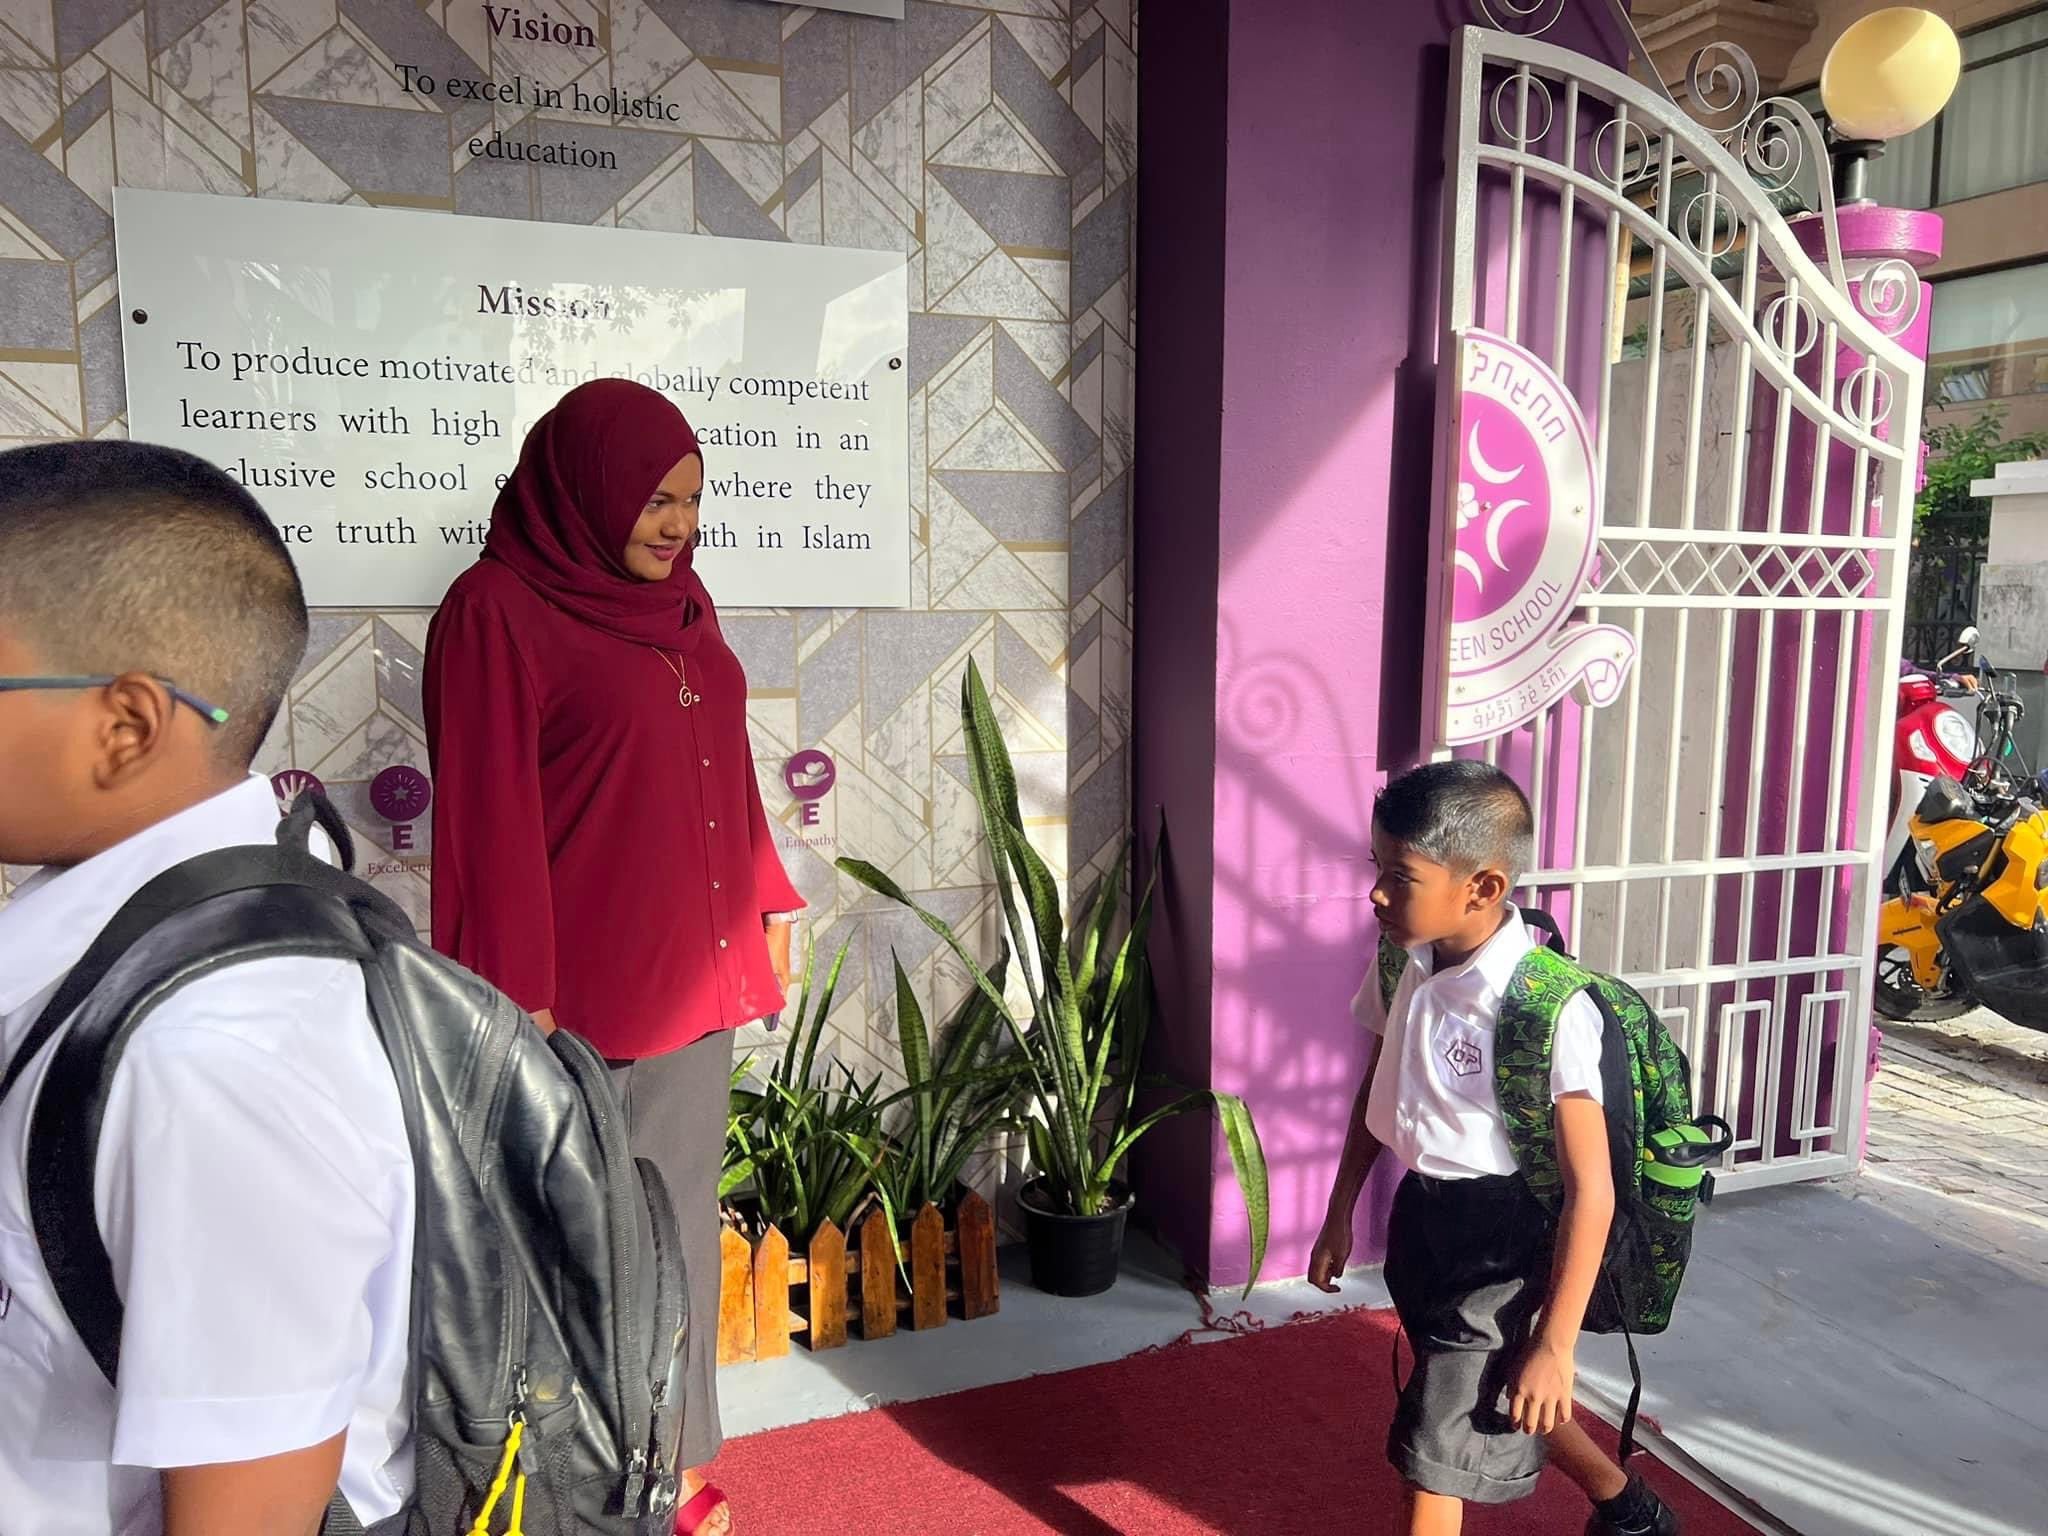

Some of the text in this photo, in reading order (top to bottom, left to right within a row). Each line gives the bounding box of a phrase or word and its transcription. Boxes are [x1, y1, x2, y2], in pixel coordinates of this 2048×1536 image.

[482, 4, 597, 49] Vision
[394, 62, 681, 122] To excel in holistic
[468, 130, 618, 170] education
[176, 341, 221, 371] To
[231, 345, 370, 381] produce
[379, 355, 537, 385] motivated
[546, 361, 598, 386] and
[729, 375, 870, 405] competent
[180, 398, 317, 432] learners
[338, 405, 411, 435] with
[431, 408, 502, 446] high
[696, 422, 778, 448] cation
[796, 424, 822, 449] in
[839, 432, 870, 451] an
[364, 462, 468, 491] school
[708, 471, 793, 499] where
[815, 474, 872, 509] they
[335, 516, 417, 544] truth
[695, 521, 738, 549] ith
[757, 524, 784, 549] in
[801, 524, 872, 550] Islam
[1450, 579, 1563, 661] EEN SCHOOL
[803, 803, 820, 826] E
[392, 825, 414, 850] E
[785, 833, 838, 849] Empathy
